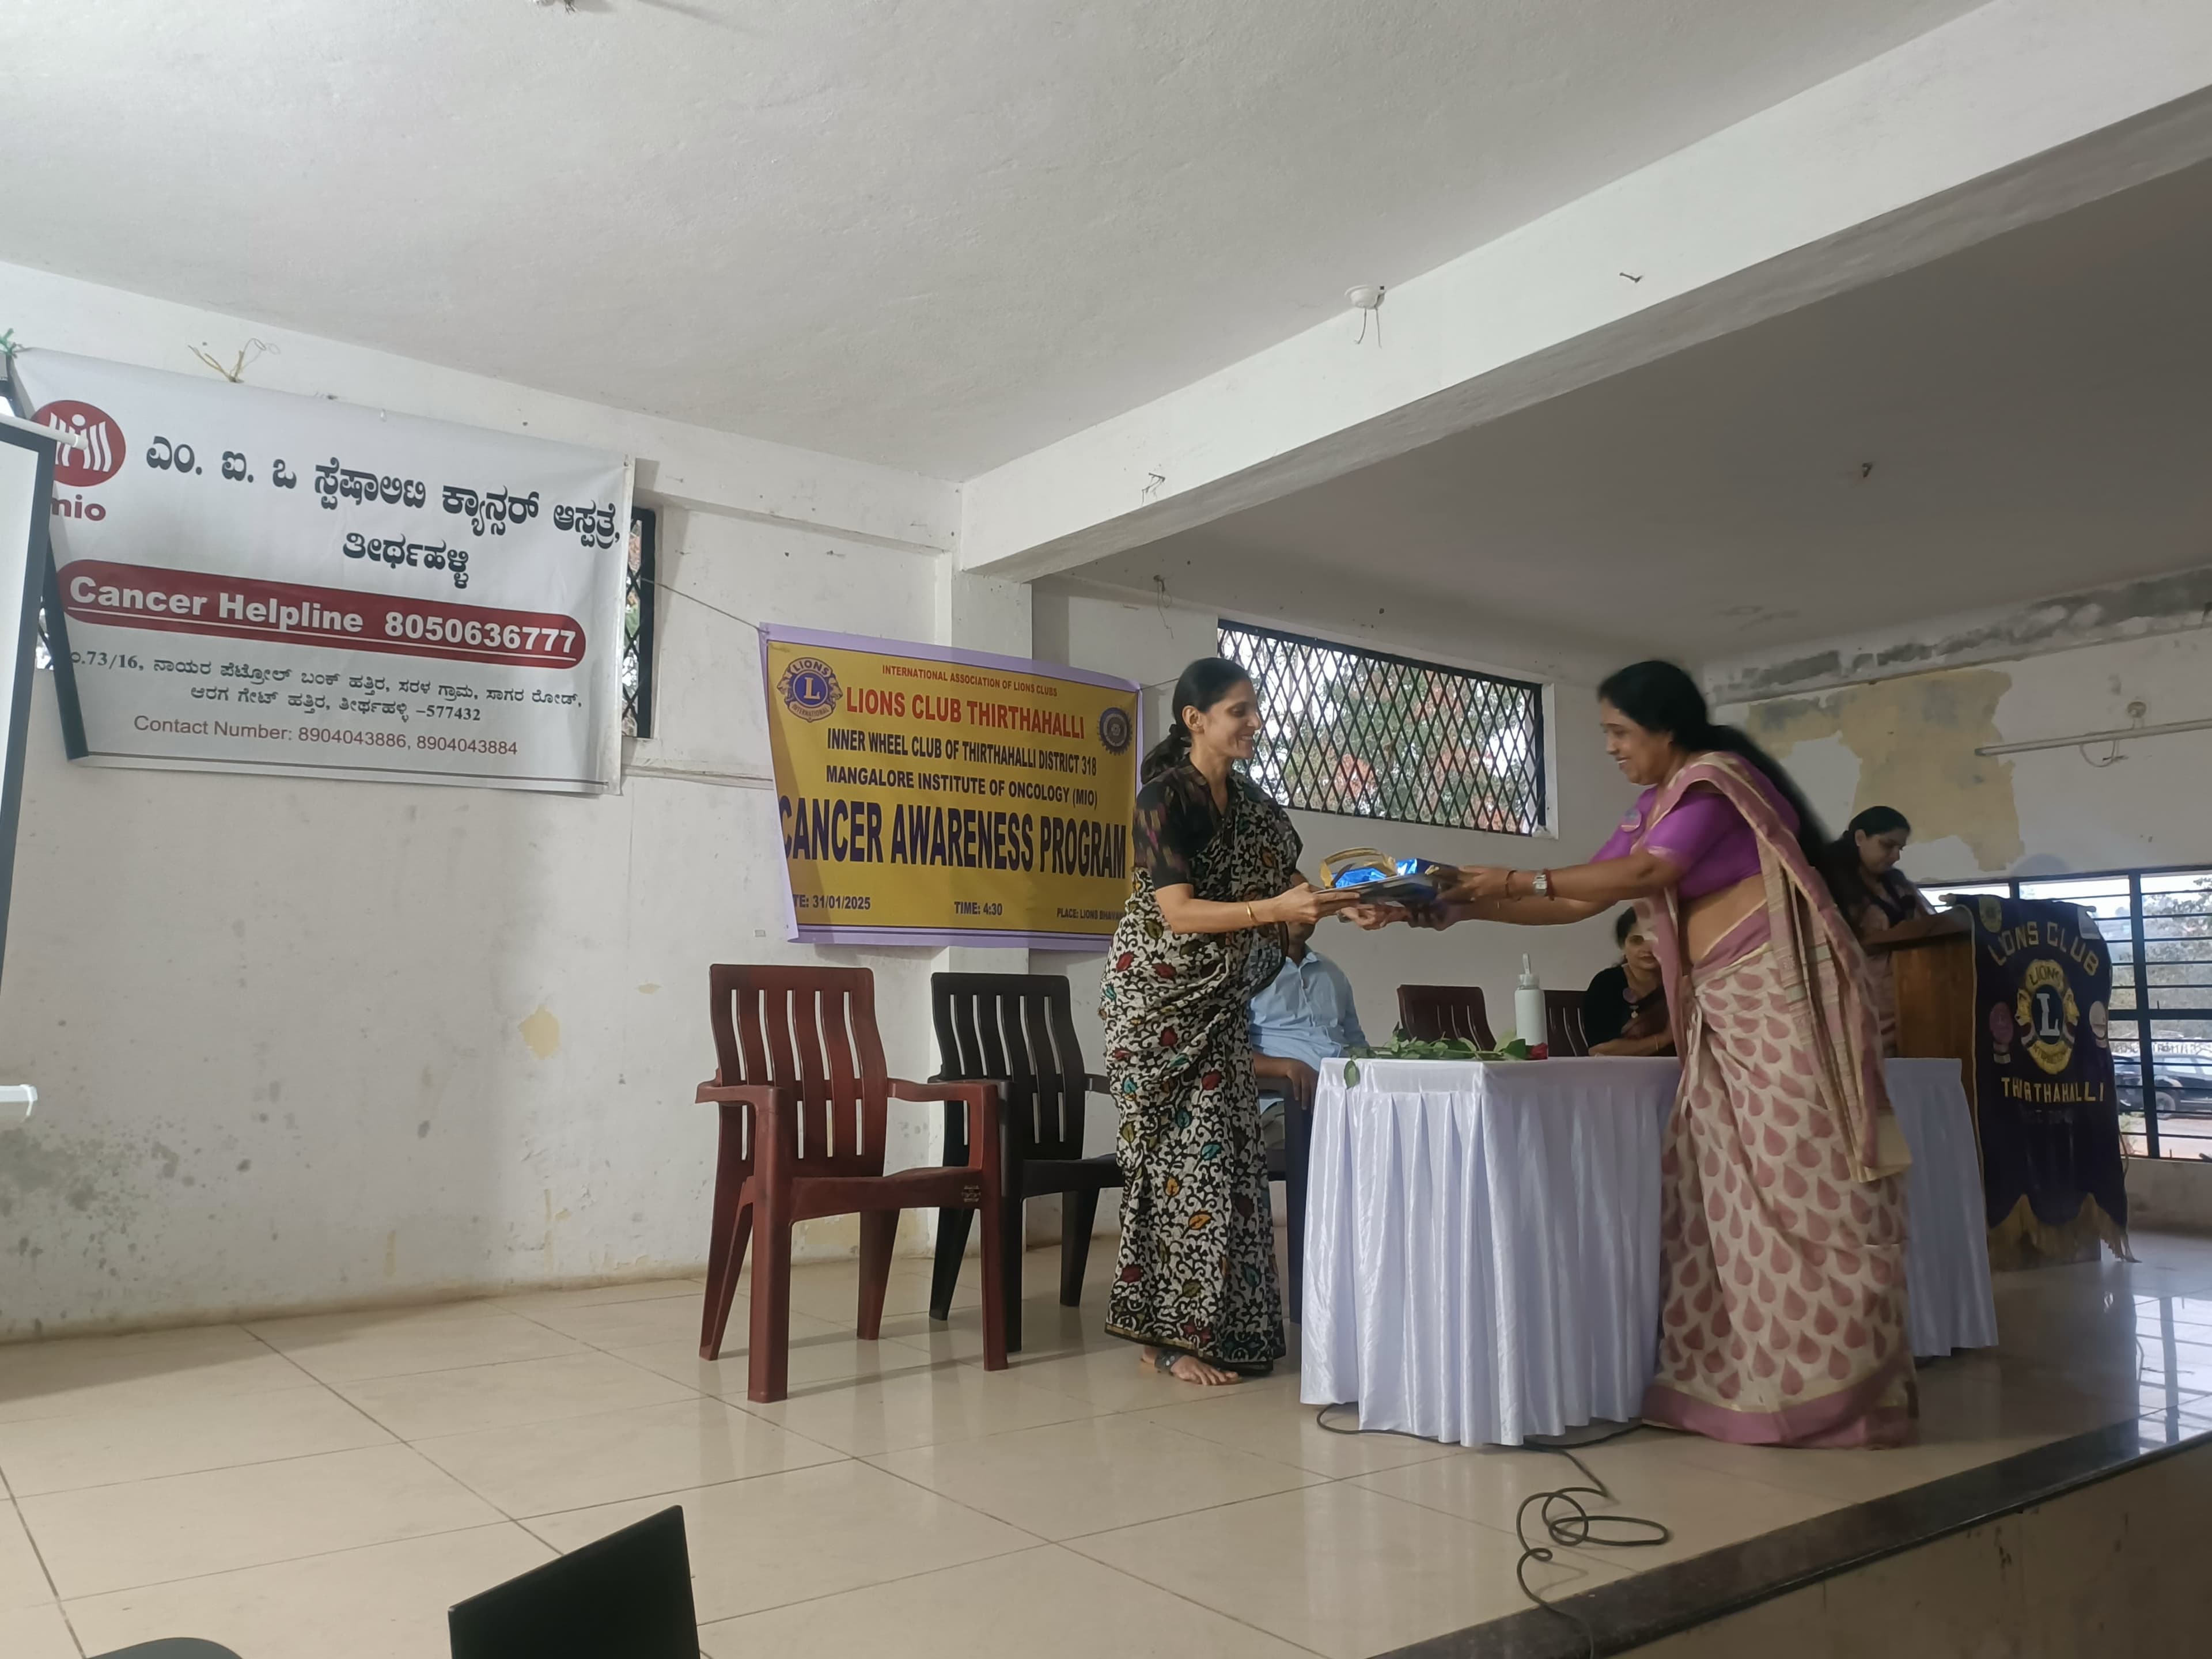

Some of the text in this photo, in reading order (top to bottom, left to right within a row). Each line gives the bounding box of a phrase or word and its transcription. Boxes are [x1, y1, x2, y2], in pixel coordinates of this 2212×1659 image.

[50, 494, 107, 521] mio
[146, 435, 620, 550] ಎಂ. ಐ. ಒ ಸ್ಪೆಷಾಲಿಟಿ ಕ್ಯಾನ್ಸರ್ ಆಸ್ಪತ್ರೆ,
[342, 532, 469, 589] ತೀರ್ಥಹಳ್ಳಿ
[69, 575, 576, 654] Cancer Helpline 8050636777
[153, 658, 212, 675] ನಾಯರ
[219, 662, 292, 684] ಪೆಟ್ರೋಲ್
[301, 672, 341, 686] ಬಂಕ್
[349, 675, 390, 696] ಹತ್ತಿರ,
[398, 679, 431, 695] ಸರಳ
[438, 684, 479, 702] ಗ್ರಾಮ,
[486, 688, 525, 702] ಸಾಗರ
[531, 689, 582, 708] ರೋಡ್,
[792, 660, 830, 677] LIONS
[803, 676, 820, 700] L
[882, 664, 1058, 697] INTERNATIONAL ASSOCIATION OF LIONS CLUBS
[237, 687, 279, 704] ಗೇಟ್
[287, 692, 331, 714] ಹತ್ತಿರ,
[338, 696, 410, 723] ತೀರ್ಥಹಳ್ಳಿ
[846, 686, 906, 718] LIONS
[912, 694, 962, 723] CLUB
[966, 700, 1085, 740] THIRTHAHALLI
[134, 715, 518, 755] Contact Number: 8904043886, 8904043884
[827, 728, 1097, 777] INNER WHEEL CLUB OF THIRTHAHALLI DISTRICT 318
[825, 764, 1098, 810] MANGALORE INSTITUTE OF ONCOLOGY (MIO)
[779, 794, 1127, 880] CANCER AWARENESS PROGRAM
[812, 895, 871, 910] 31/01/2025
[953, 901, 1003, 916] TIME: 4:30
[1056, 907, 1079, 918] PLACE:
[1080, 909, 1099, 920] LIONS
[2046, 921, 2099, 977] CLUB
[2036, 993, 2061, 1036] L
